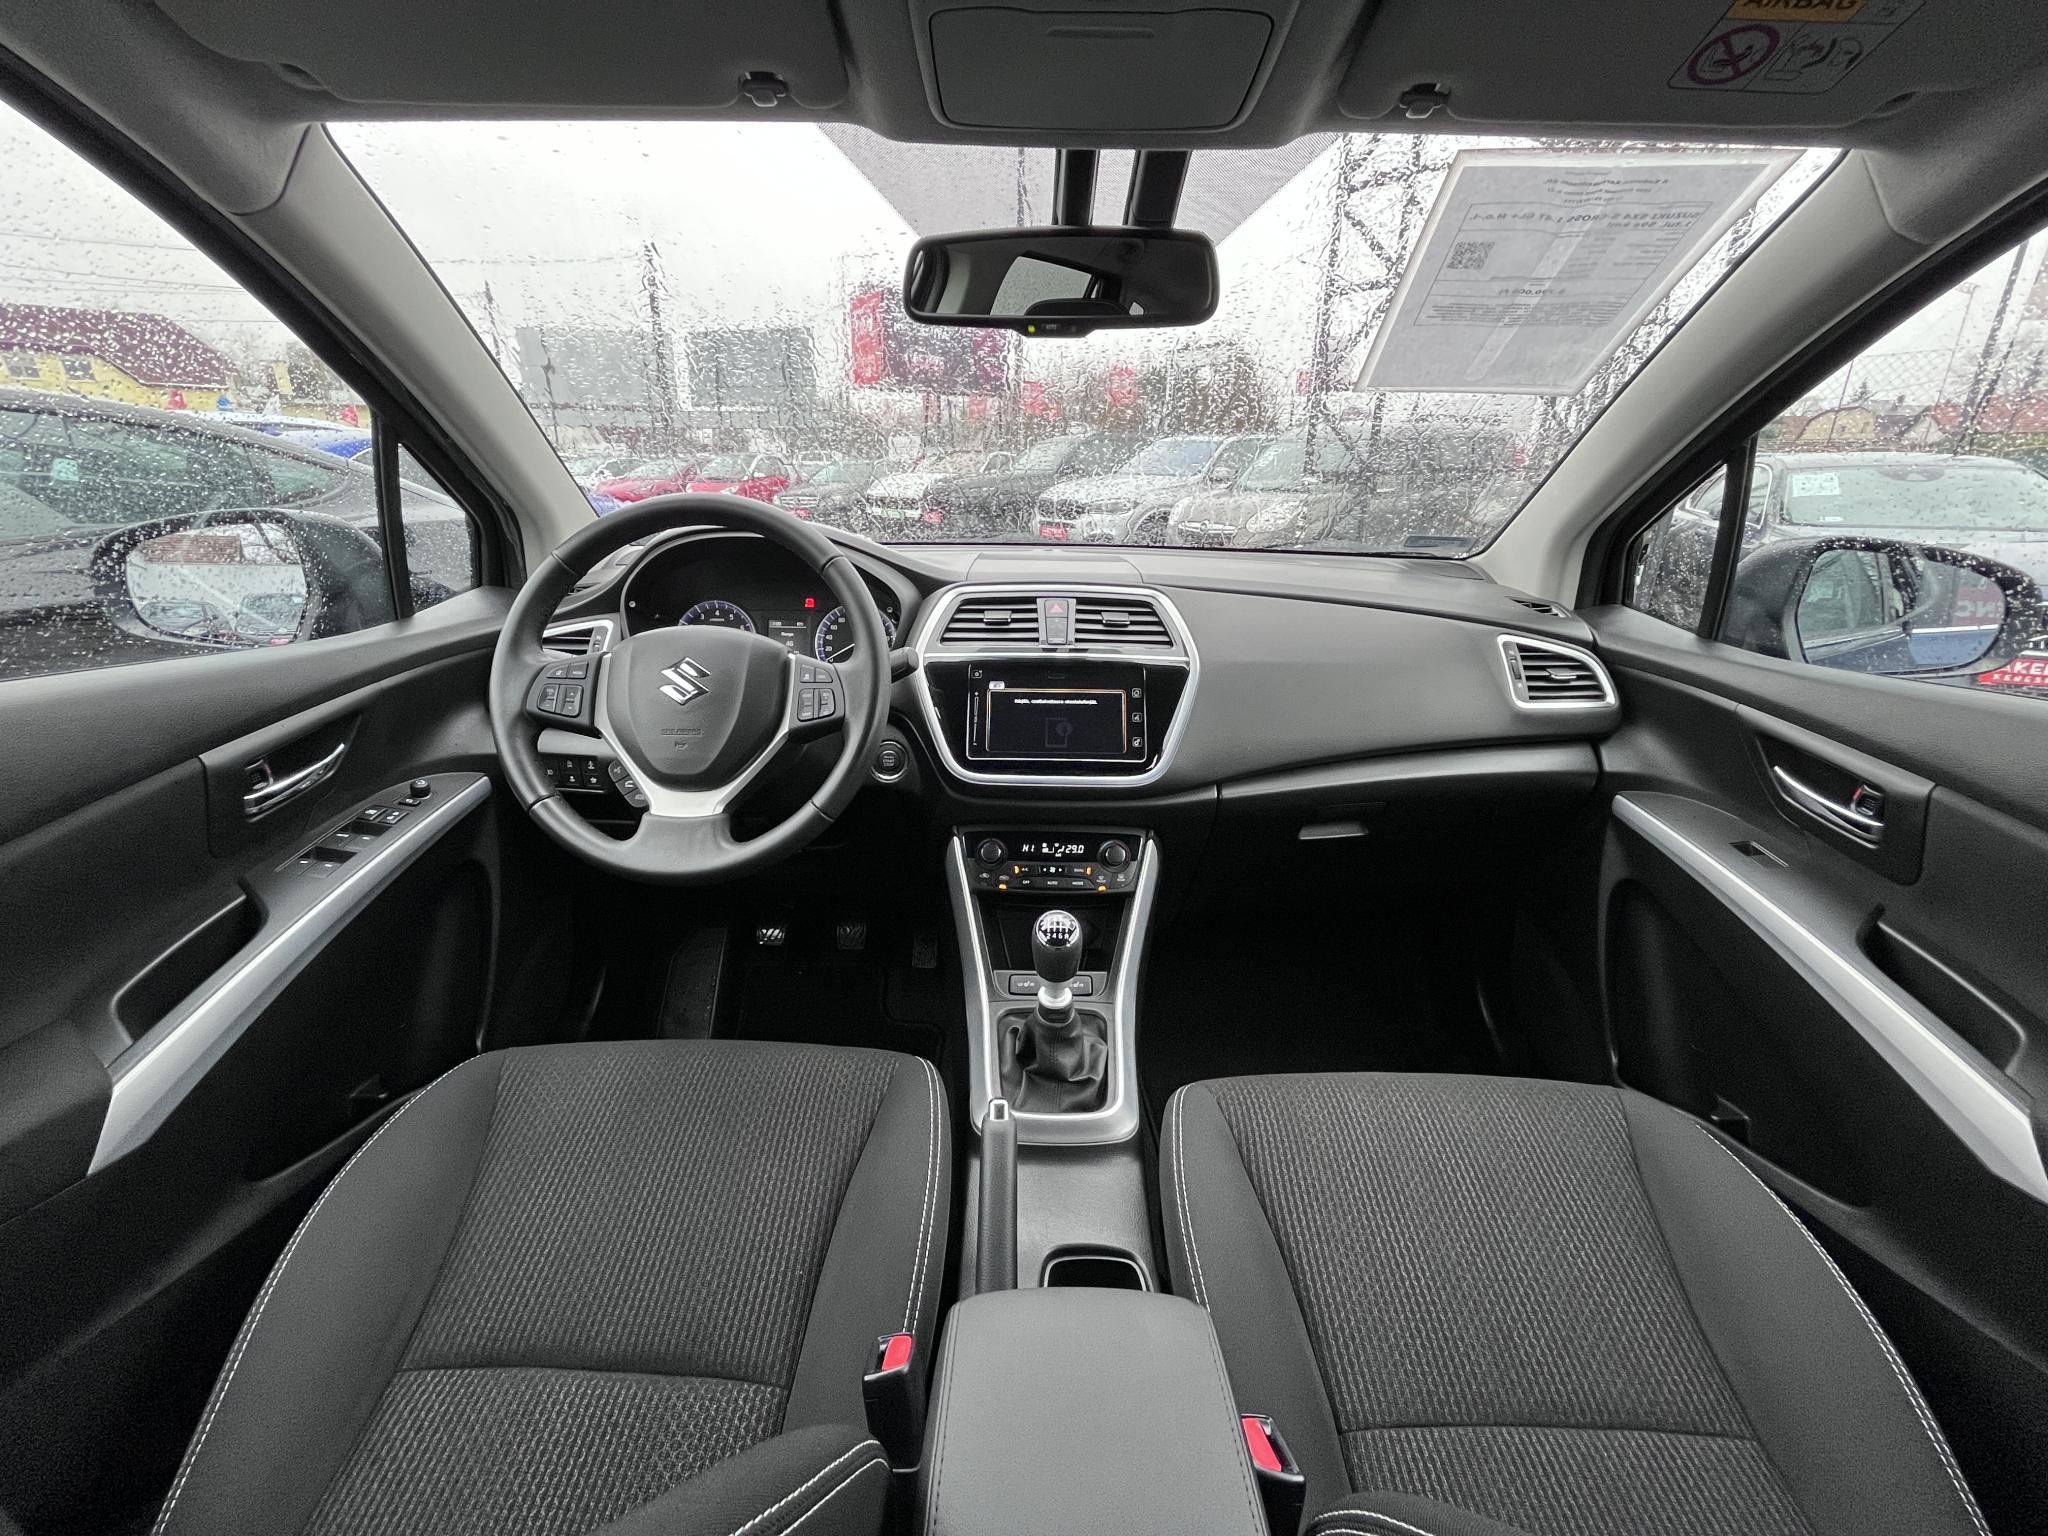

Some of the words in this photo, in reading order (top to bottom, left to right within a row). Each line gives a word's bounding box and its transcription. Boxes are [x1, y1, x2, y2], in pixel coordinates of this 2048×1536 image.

[729, 613, 734, 621] 5
[2000, 661, 2048, 675] KE
[1065, 844, 1085, 854] 29.0
[1046, 932, 1051, 940] 2
